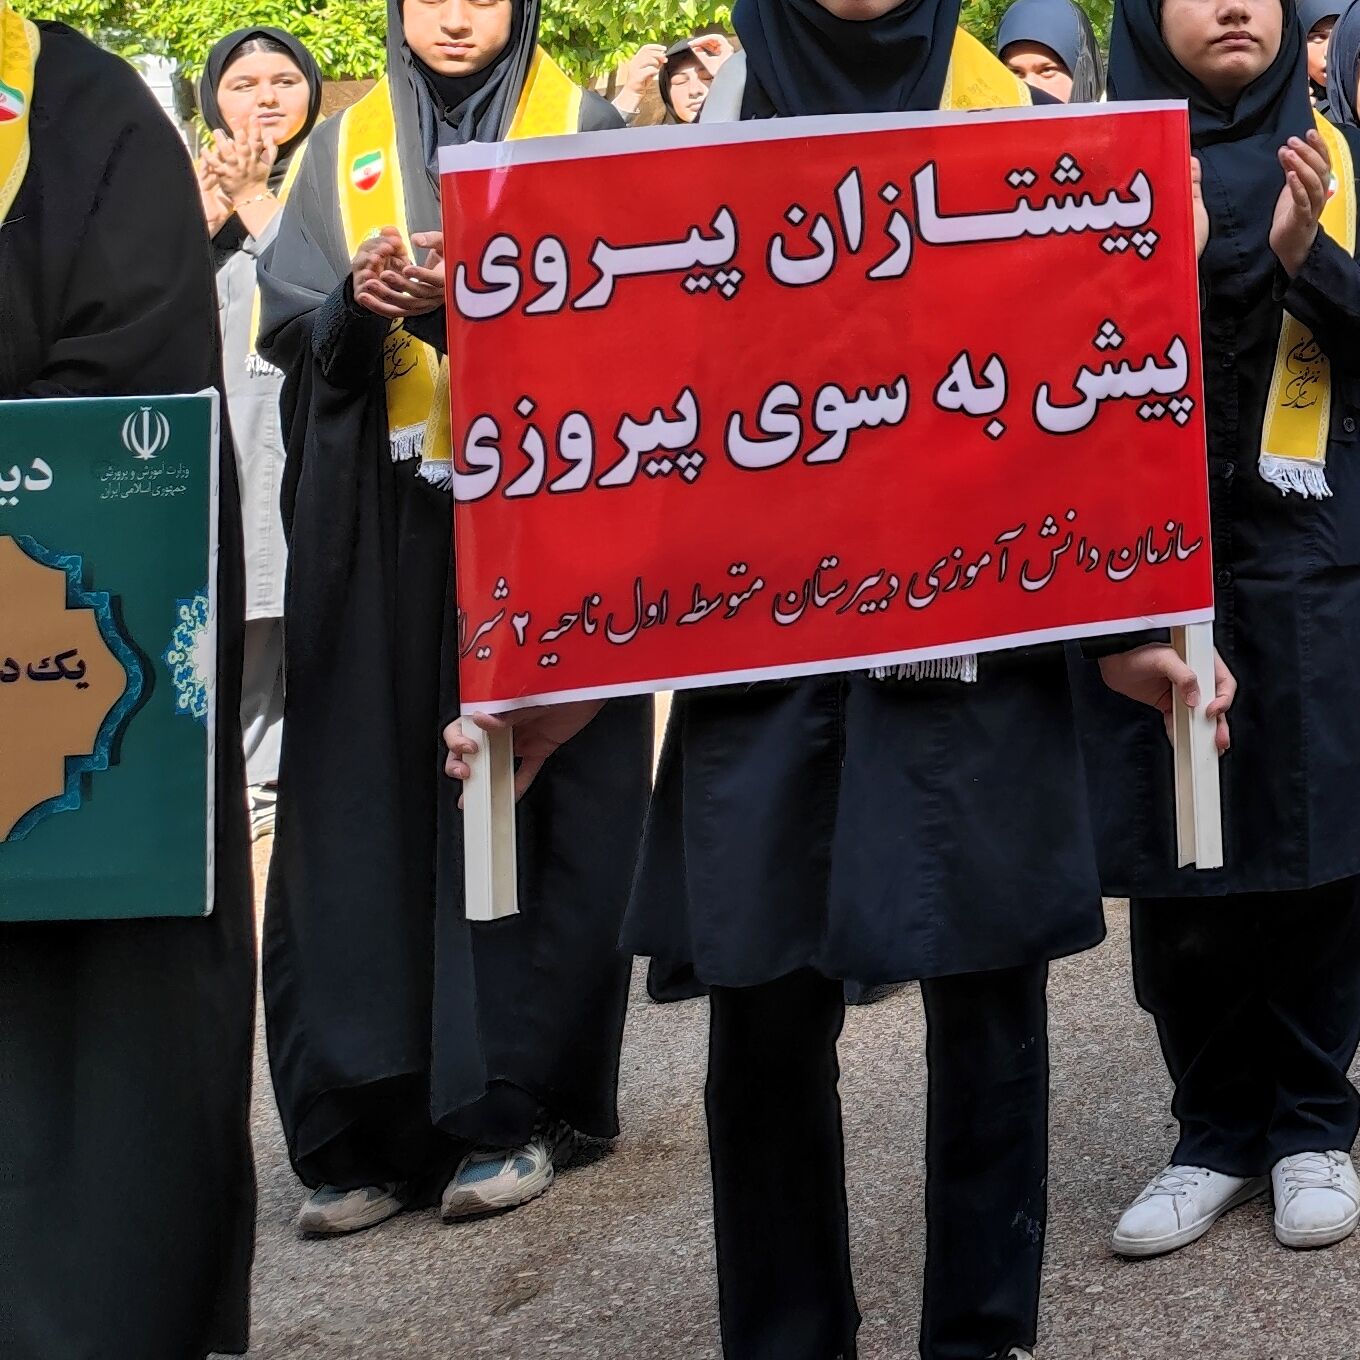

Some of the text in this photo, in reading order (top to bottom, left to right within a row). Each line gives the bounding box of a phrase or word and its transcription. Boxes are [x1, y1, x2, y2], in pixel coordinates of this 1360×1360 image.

[453, 152, 1161, 321] پیشتازان پیروی
[453, 318, 1196, 505] پیش به سوی پیروزی
[905, 522, 1027, 609] آموزی
[1018, 508, 1100, 593] دانش
[1106, 520, 1204, 583] سازمان
[456, 577, 507, 659] شیرا
[509, 610, 531, 647] ۲
[537, 592, 602, 667] ناحیه
[605, 576, 668, 646] اول
[772, 554, 899, 627] دبیرستان
